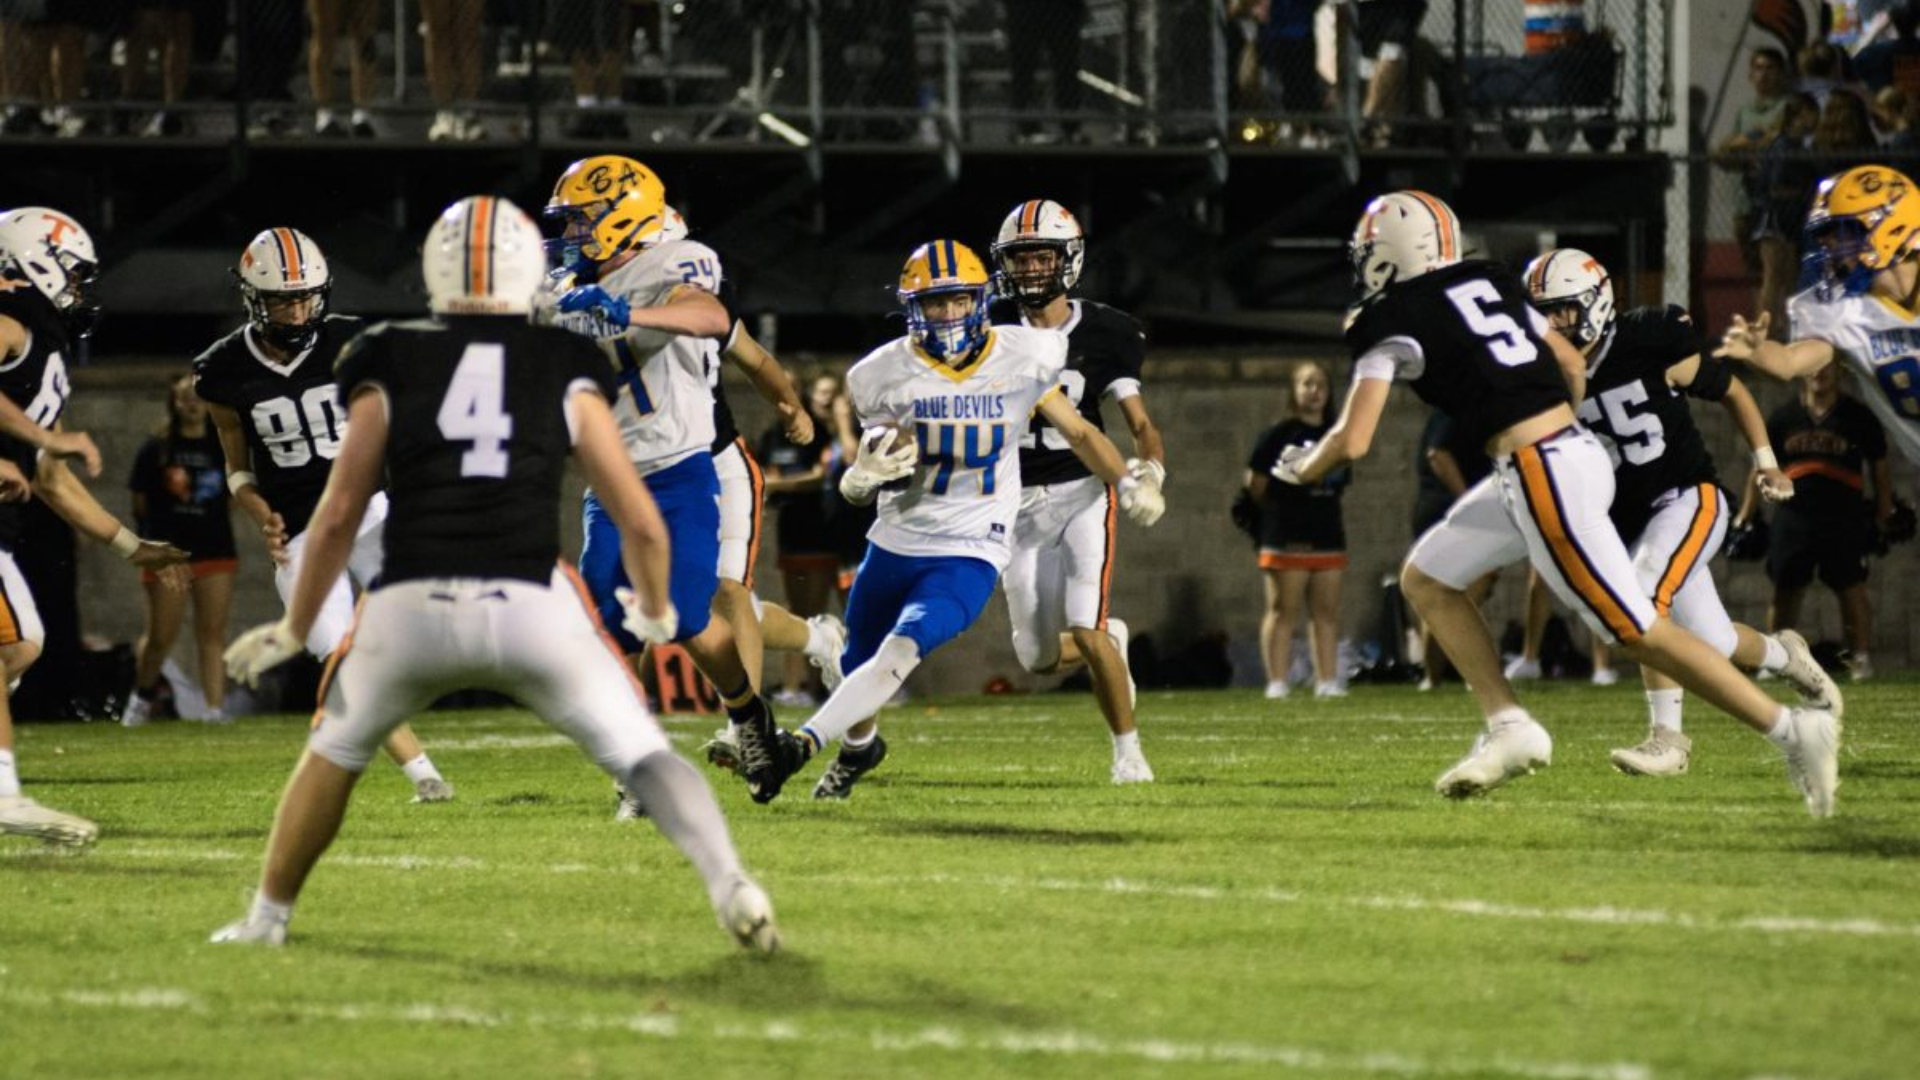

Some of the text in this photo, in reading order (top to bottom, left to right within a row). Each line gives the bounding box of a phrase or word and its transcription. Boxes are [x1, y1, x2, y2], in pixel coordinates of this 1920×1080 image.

[586, 162, 646, 195] BA
[42, 213, 78, 245] T
[677, 257, 716, 291] 24
[1444, 278, 1538, 367] 5
[250, 383, 347, 468] 80
[436, 342, 512, 478] 4
[914, 394, 1004, 419] BLUE DEVILS
[915, 422, 1005, 496] 44
